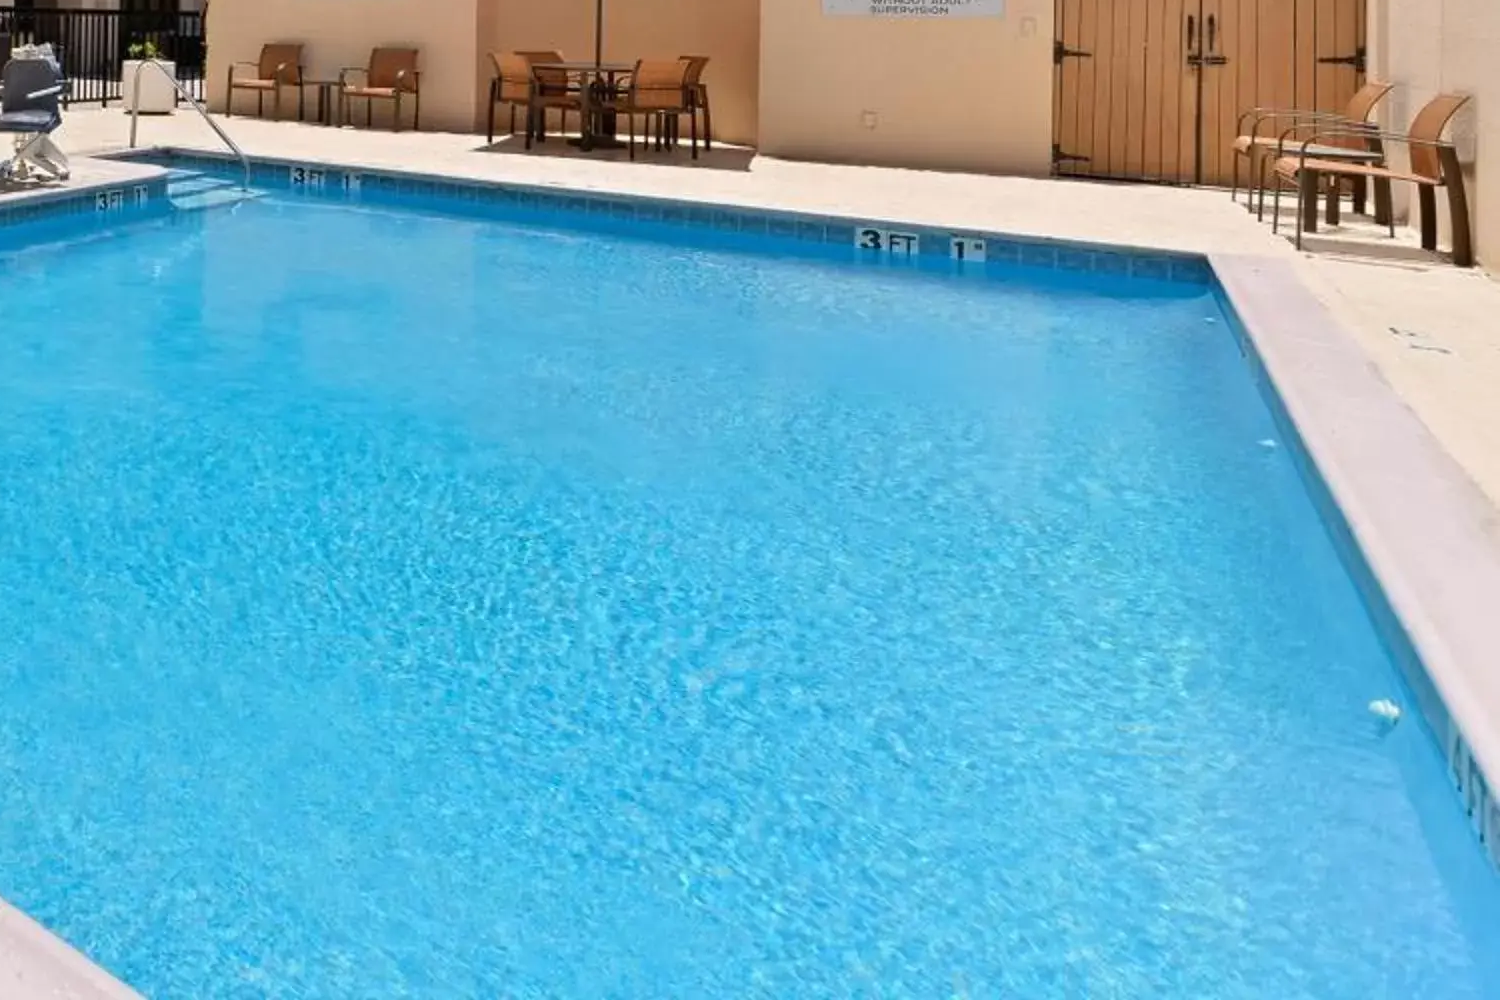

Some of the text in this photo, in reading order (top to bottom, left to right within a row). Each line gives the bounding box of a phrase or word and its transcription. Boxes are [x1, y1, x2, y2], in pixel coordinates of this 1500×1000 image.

[870, 5, 950, 16] SUPERVISION
[860, 228, 882, 250] 3
[889, 233, 917, 256] FT
